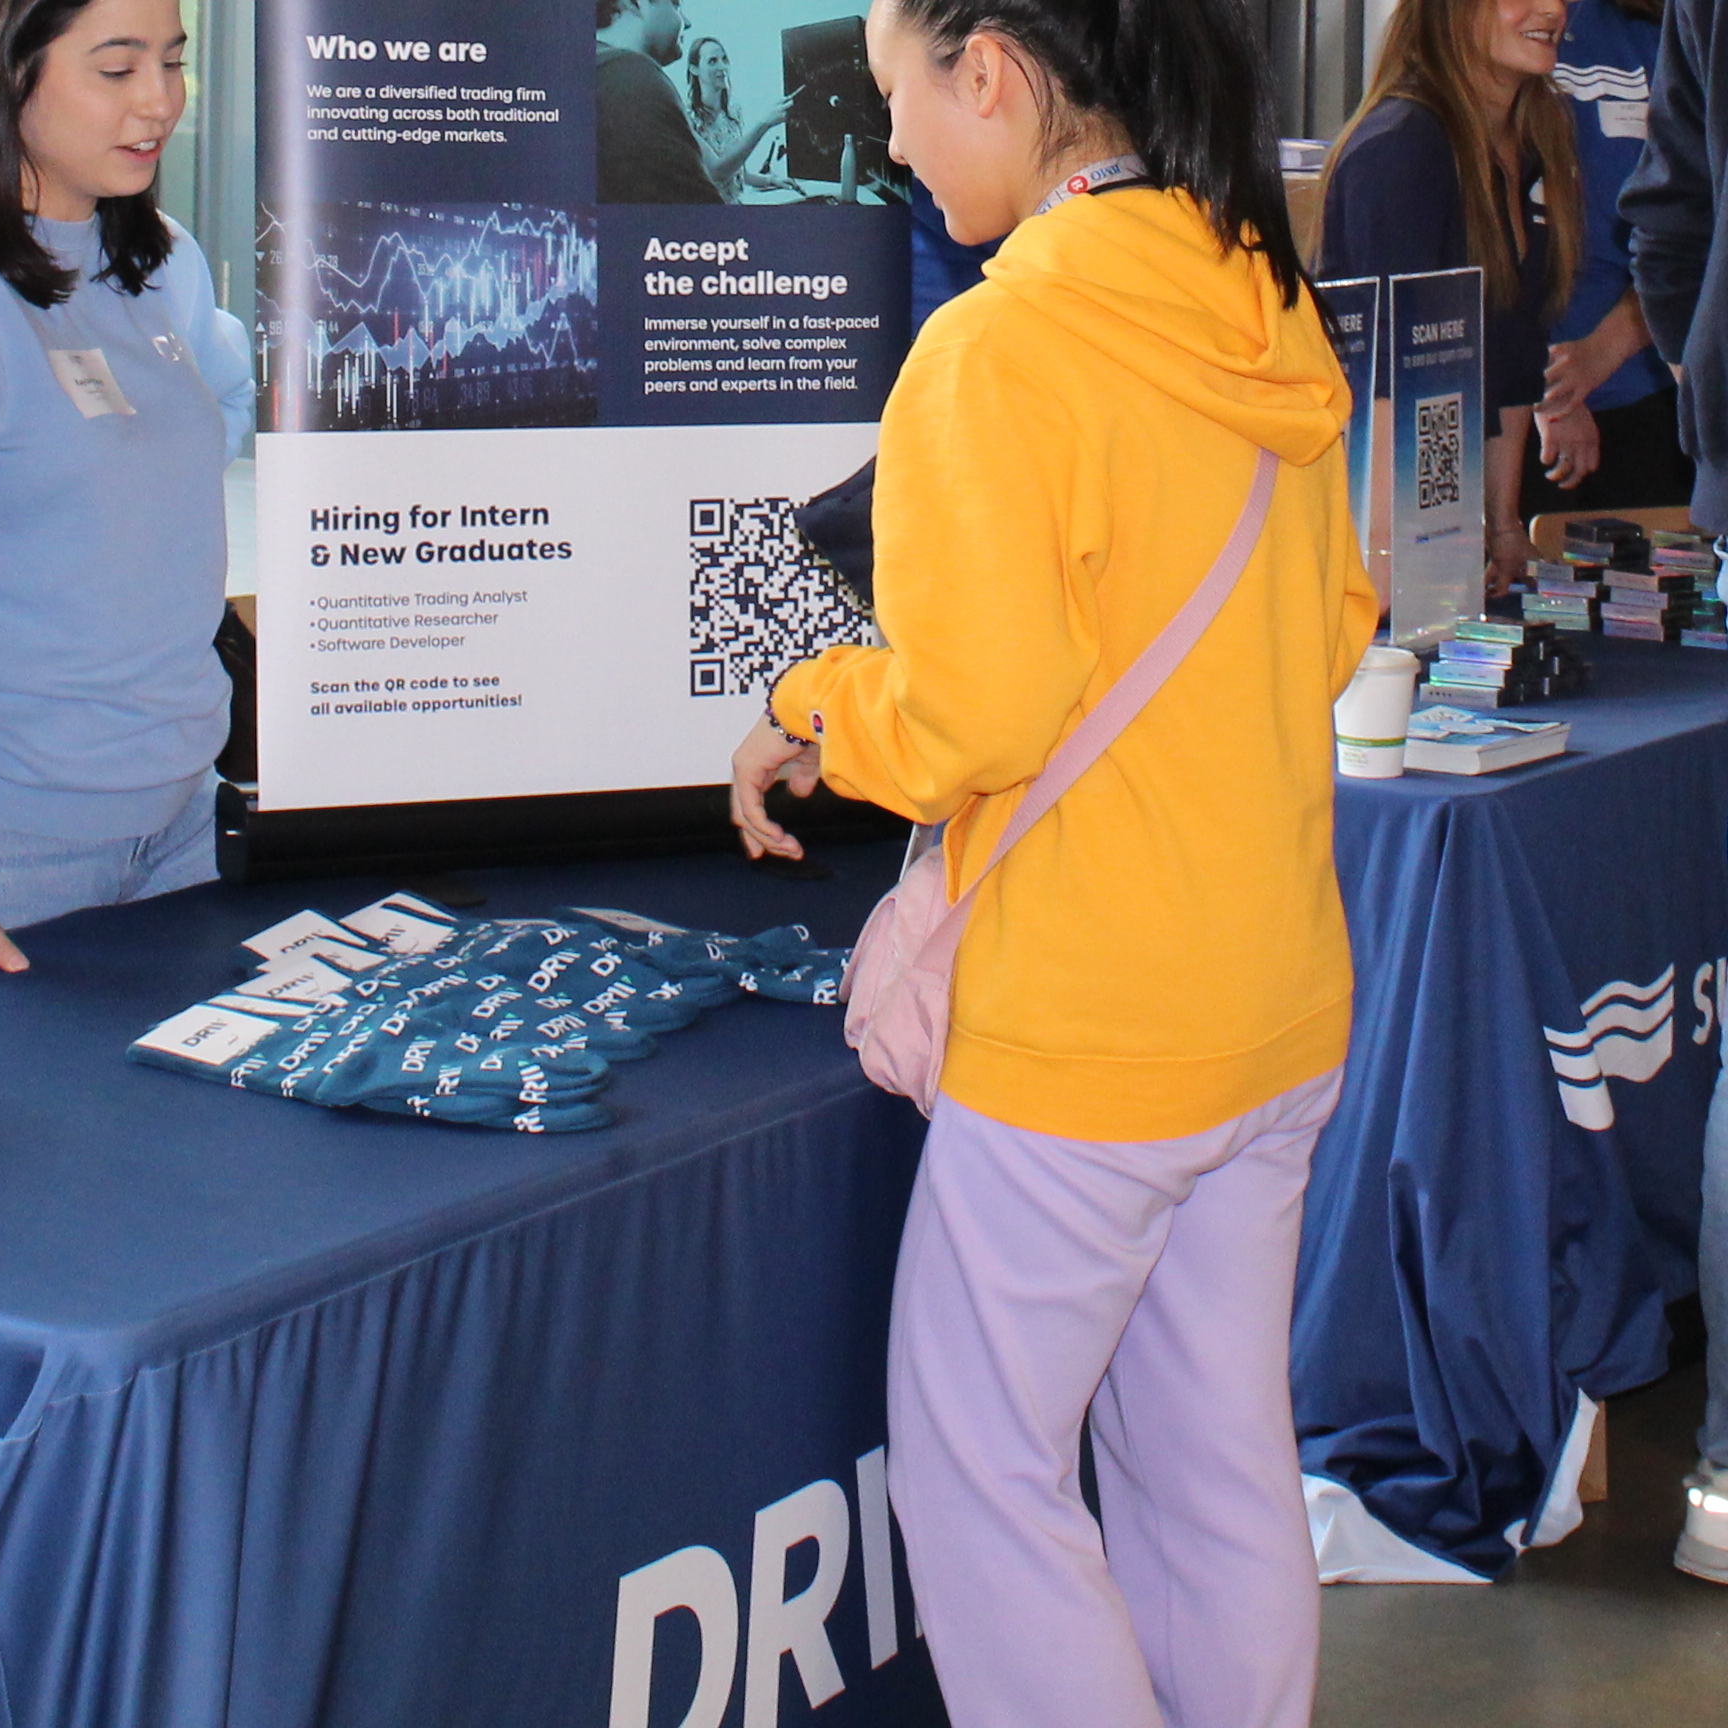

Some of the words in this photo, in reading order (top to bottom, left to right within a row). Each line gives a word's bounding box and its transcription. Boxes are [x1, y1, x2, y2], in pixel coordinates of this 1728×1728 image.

[306, 35, 377, 61] Who
[384, 41, 431, 62] we
[438, 41, 488, 63] are
[306, 85, 332, 99] We
[336, 87, 361, 100] are
[365, 88, 376, 100] a
[379, 84, 457, 101] diversified
[460, 86, 512, 104] trading
[516, 87, 546, 102] firm
[306, 106, 389, 123] innovating
[392, 108, 443, 121] across
[446, 107, 480, 122] both
[483, 108, 560, 123] traditional
[307, 127, 338, 141] and
[342, 128, 441, 144] cutting-edge
[444, 128, 508, 143] markets.
[643, 237, 749, 266] Accept
[644, 270, 694, 296] the
[701, 270, 848, 301] challenge
[644, 316, 708, 331] Immerse
[710, 315, 769, 333] yourself
[772, 316, 786, 330] in
[789, 319, 800, 330] a
[802, 315, 880, 331] fast-paced
[1412, 323, 1438, 345] SCAN
[1440, 318, 1465, 340] HERE
[644, 337, 739, 352] environment,
[742, 336, 781, 351] solve
[784, 336, 847, 353] complex
[644, 357, 713, 375] problems
[715, 356, 745, 371] and
[748, 356, 786, 371] learn
[788, 355, 823, 370] from
[825, 357, 858, 373] your
[644, 379, 686, 395] peers
[689, 377, 718, 393] and
[721, 377, 777, 394] experts
[780, 376, 794, 391] in
[797, 376, 821, 390] the
[824, 375, 858, 390] field.
[310, 505, 400, 535] Hiring
[409, 504, 452, 529] for
[460, 504, 550, 528] Intern
[310, 544, 330, 567] &
[340, 543, 407, 566] New
[415, 538, 573, 564] Graduates
[317, 594, 410, 610] Quantitative
[414, 591, 469, 608] Trading
[472, 589, 528, 606] Analyst
[317, 615, 410, 632] Quantitative
[414, 612, 499, 628] Researcher
[317, 636, 385, 652] Software
[390, 633, 466, 650] Developer
[310, 681, 350, 694] Scan
[354, 679, 379, 693] the
[384, 678, 405, 692] QR
[410, 676, 448, 691] code
[453, 676, 469, 689] to
[473, 676, 500, 688] see
[310, 702, 330, 716] all
[334, 698, 407, 714] available
[412, 694, 523, 713] opportunities!
[527, 947, 582, 993] DRW
[471, 986, 523, 1020] DRW
[581, 974, 638, 1015] DRW
[181, 1017, 229, 1048] DRW
[277, 1023, 333, 1072] DRW
[401, 1035, 437, 1073] DRW
